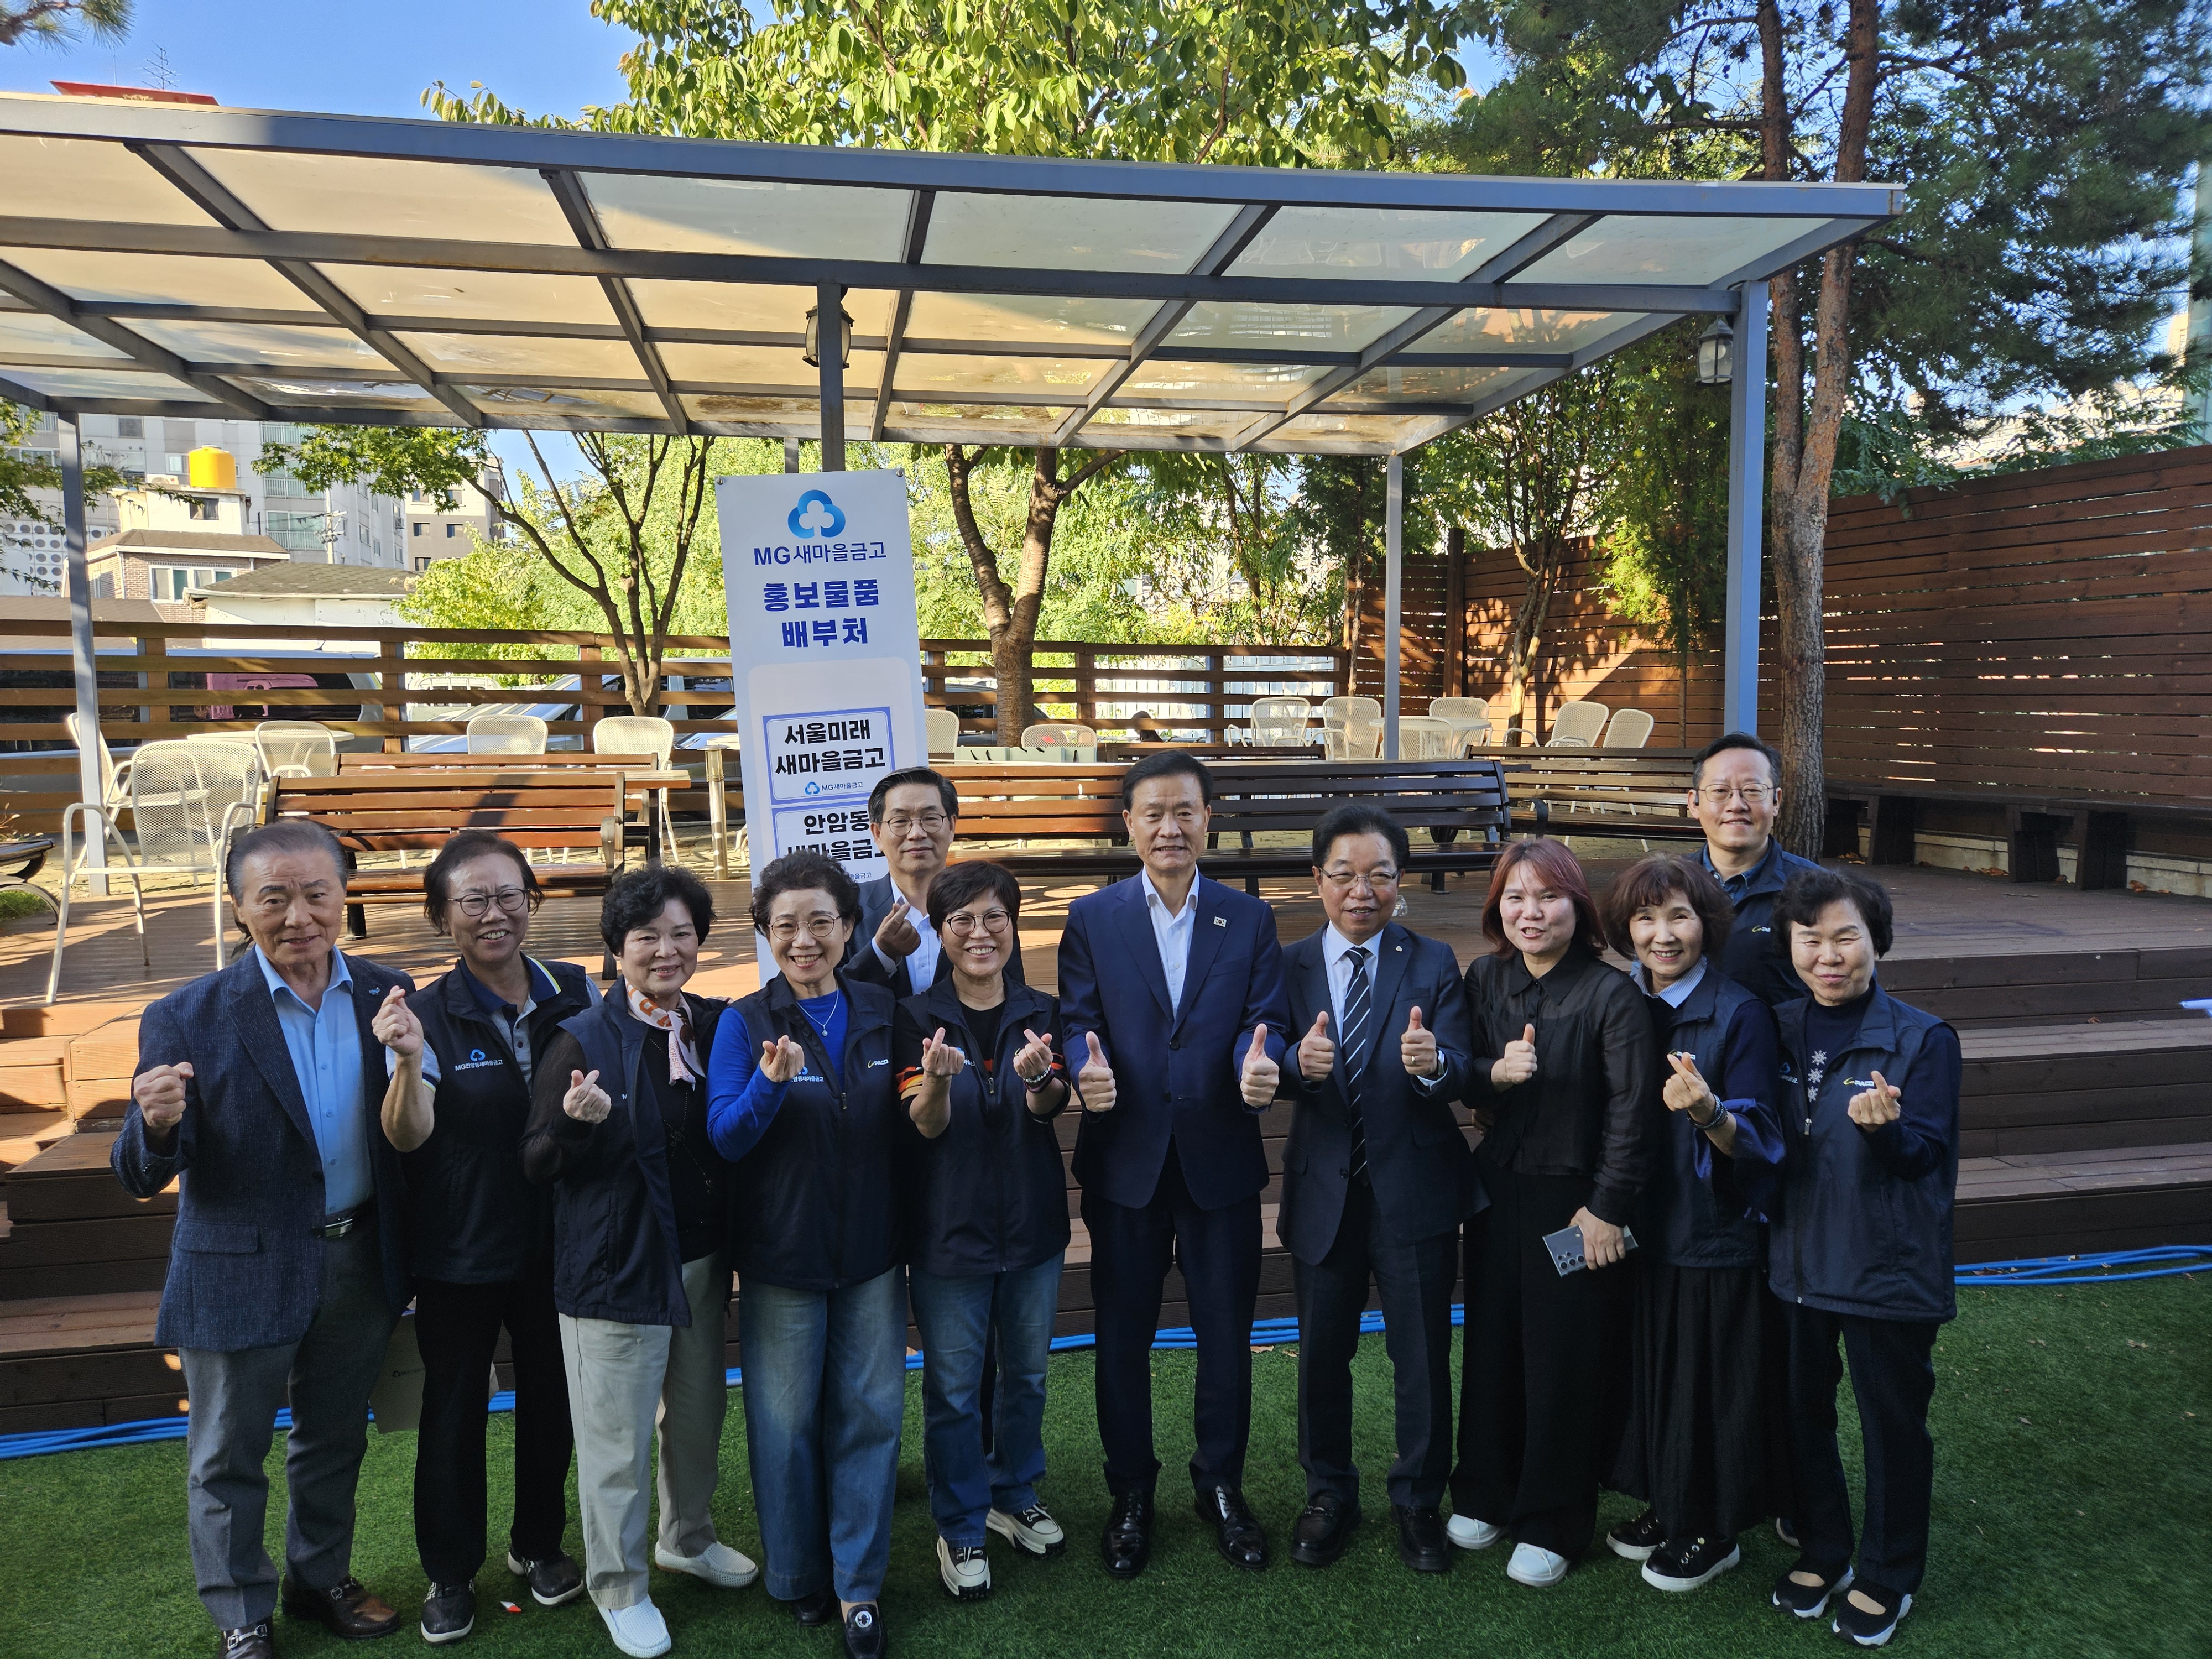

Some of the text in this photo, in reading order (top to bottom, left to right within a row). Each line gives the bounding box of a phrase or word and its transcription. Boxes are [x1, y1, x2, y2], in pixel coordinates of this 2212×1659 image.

[753, 542, 887, 565] MG새마을금고
[763, 579, 879, 612] 홍보물품
[782, 617, 869, 648] 배부처
[784, 719, 870, 744] 서울미래
[775, 747, 886, 775] 새마을금고
[822, 782, 864, 791] MG새마을금고
[804, 810, 870, 836] 안암동
